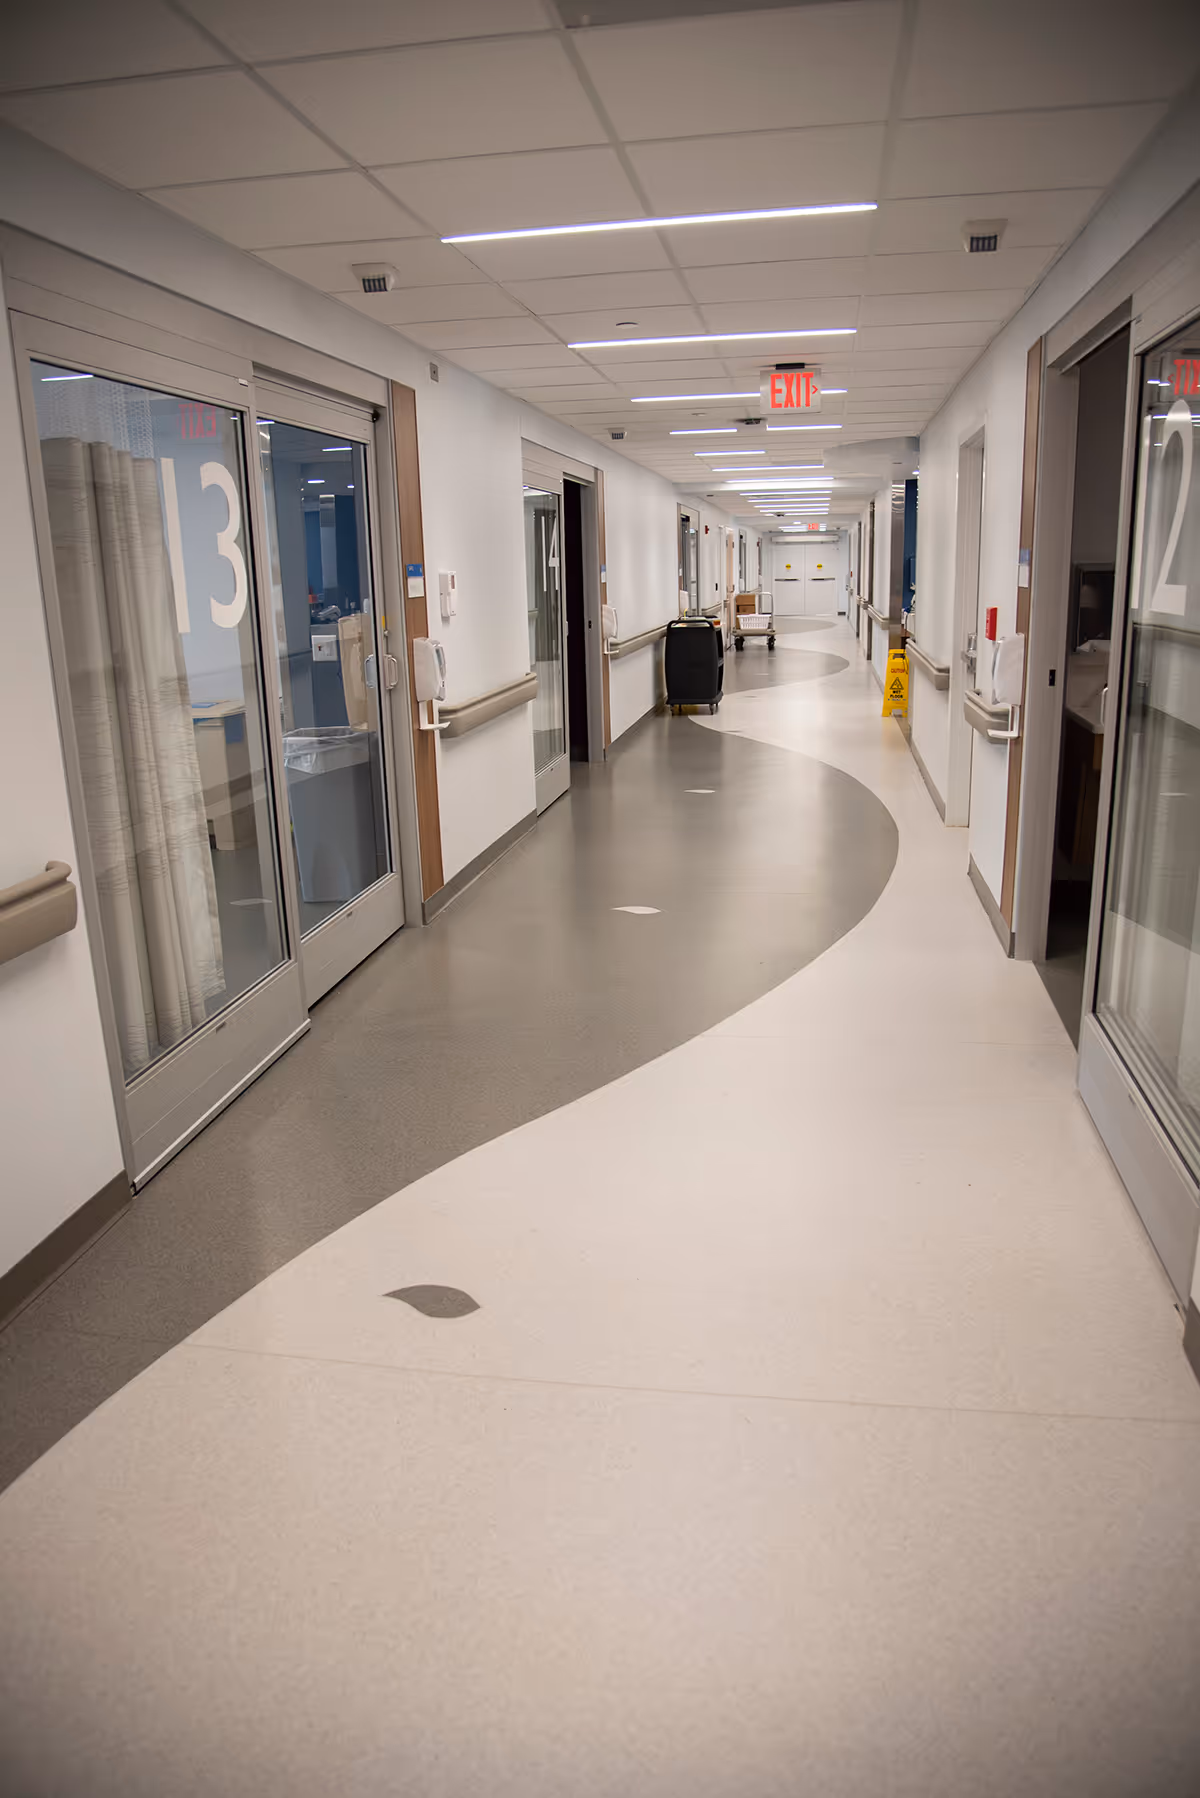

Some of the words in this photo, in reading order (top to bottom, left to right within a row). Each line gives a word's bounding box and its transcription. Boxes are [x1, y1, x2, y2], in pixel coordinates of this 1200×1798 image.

[771, 372, 814, 408] EXIT
[160, 457, 247, 633] 13
[541, 516, 559, 591] 14
[1131, 399, 1193, 616] 12
